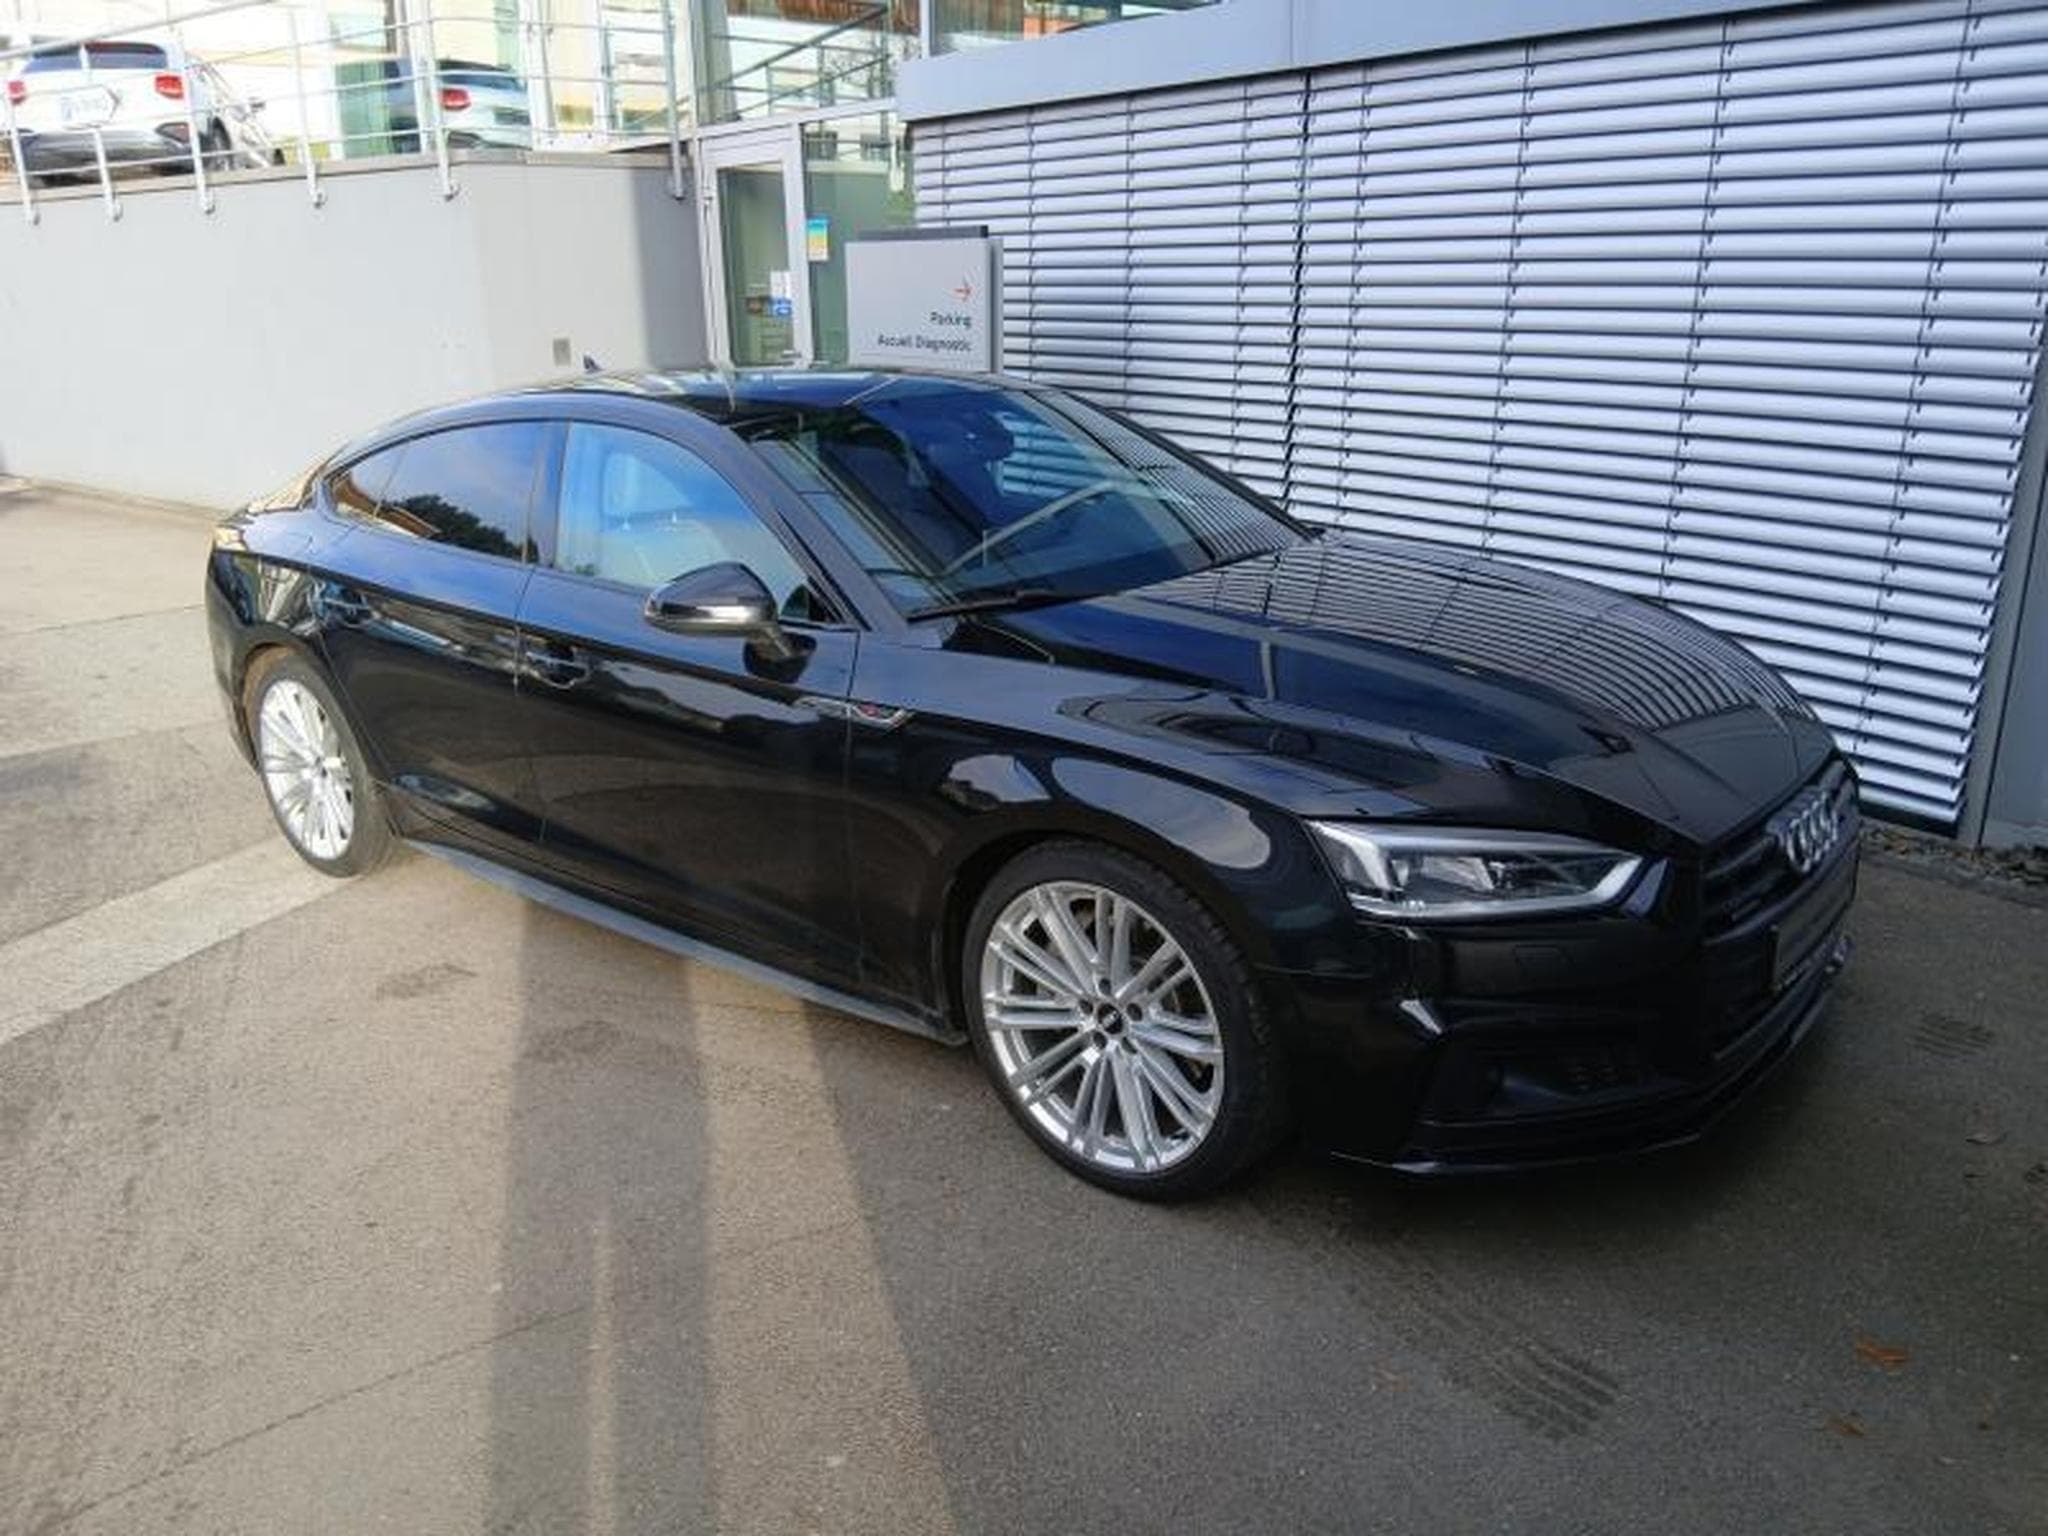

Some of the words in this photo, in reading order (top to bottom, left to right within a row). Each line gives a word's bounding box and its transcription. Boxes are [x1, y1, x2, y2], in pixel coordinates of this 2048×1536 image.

[930, 311, 971, 329] Parking
[878, 334, 912, 347] Accueil
[916, 335, 971, 352] Diagnostic
